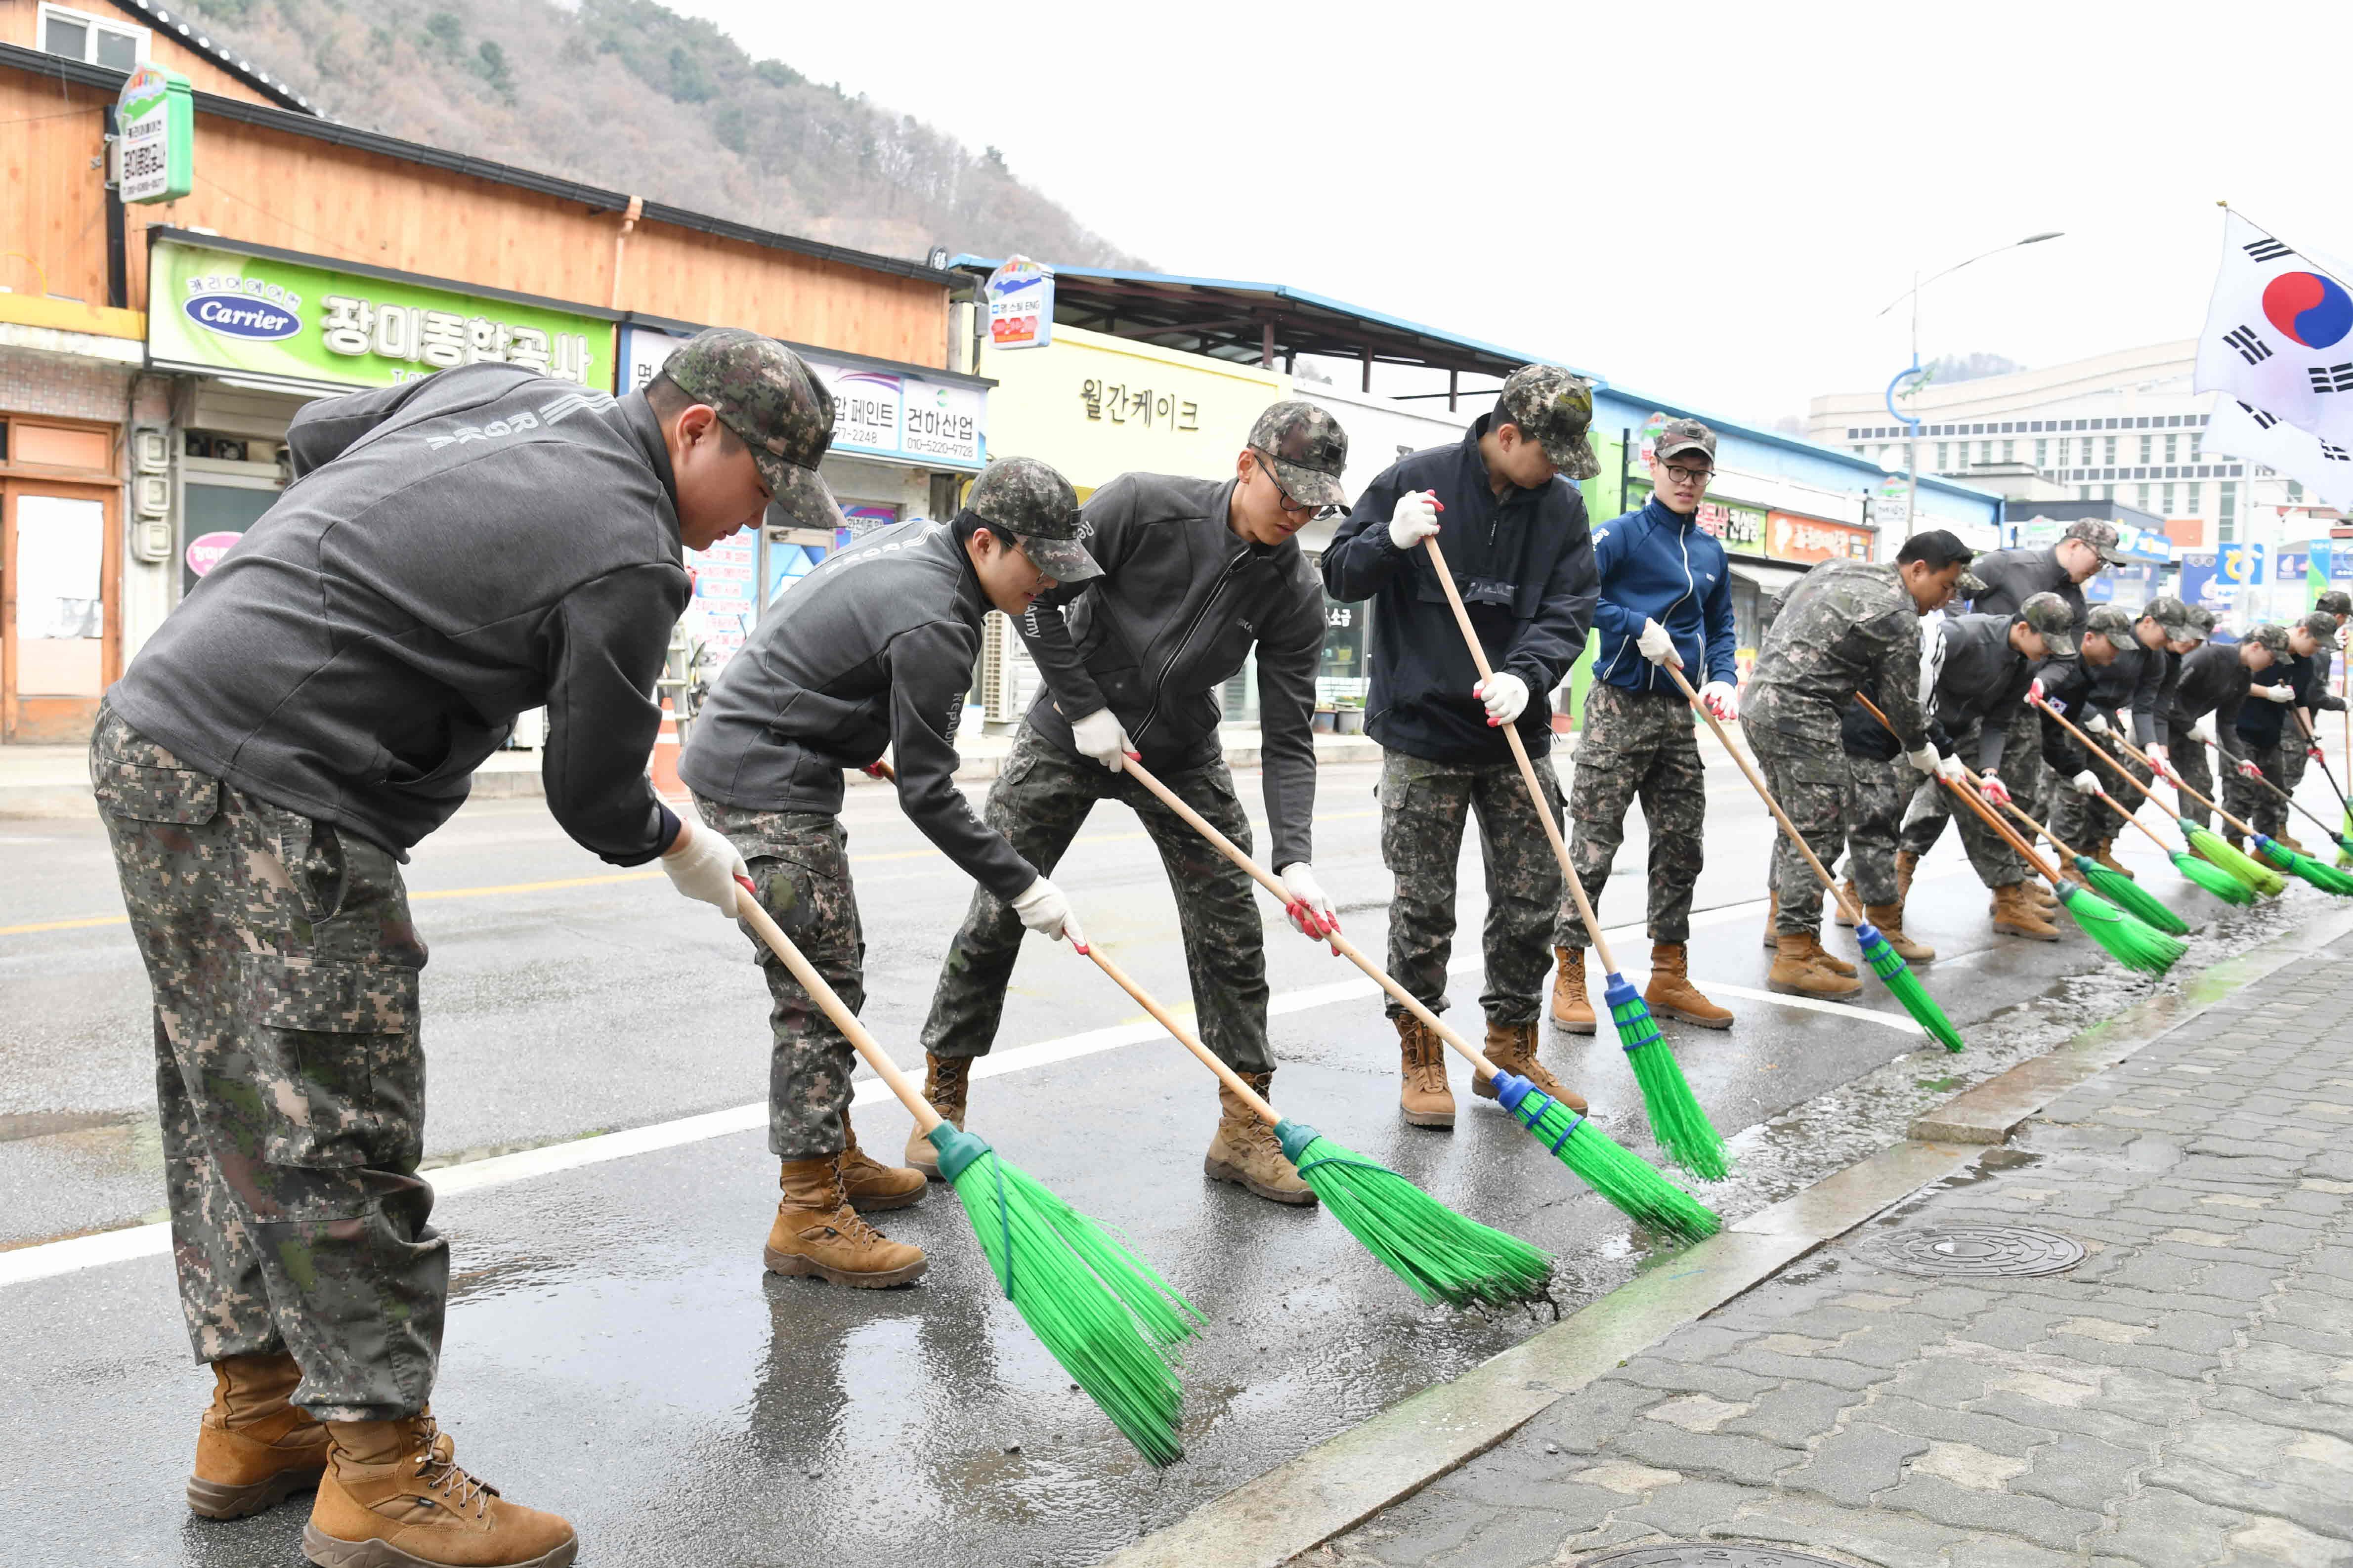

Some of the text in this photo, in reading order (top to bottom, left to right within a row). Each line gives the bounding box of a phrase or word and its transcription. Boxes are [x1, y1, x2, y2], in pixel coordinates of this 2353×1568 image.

[200, 301, 289, 331] Carrier
[324, 295, 593, 384] 장미종합공사
[851, 399, 893, 427] 페인트
[1079, 379, 1199, 431] 월간케이크
[834, 426, 878, 443] 77-2248
[1025, 605, 1041, 638] Army
[1325, 607, 1352, 627] 소금
[946, 693, 964, 746] Republ
